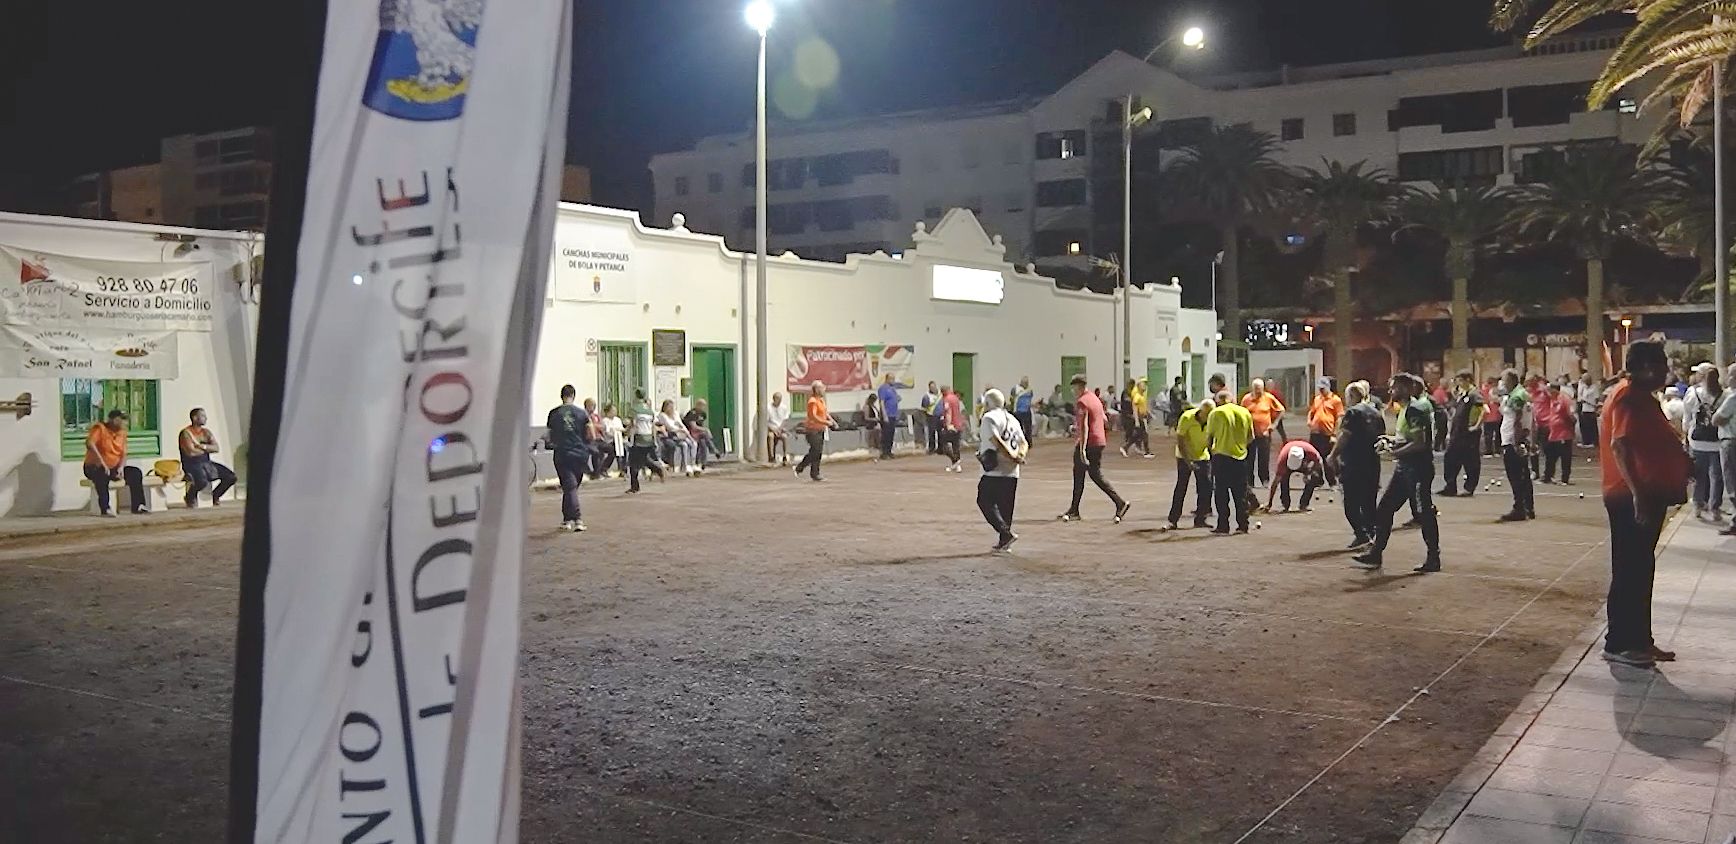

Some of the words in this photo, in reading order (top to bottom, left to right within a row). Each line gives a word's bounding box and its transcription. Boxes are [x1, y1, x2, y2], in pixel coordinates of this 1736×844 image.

[562, 248, 590, 259] CANCHAS
[591, 251, 630, 262] MUNICIPALES
[568, 260, 576, 269] DE
[577, 261, 594, 270] BOLA
[599, 263, 625, 272] PETANCA
[97, 276, 128, 292] 928
[133, 278, 154, 293] 80
[160, 278, 177, 293] 47
[181, 278, 198, 294] 06
[84, 292, 141, 309] Servicio
[144, 298, 151, 309] a
[155, 295, 212, 311] Domicilio
[24, 356, 51, 370] San
[54, 358, 94, 371] Rafael
